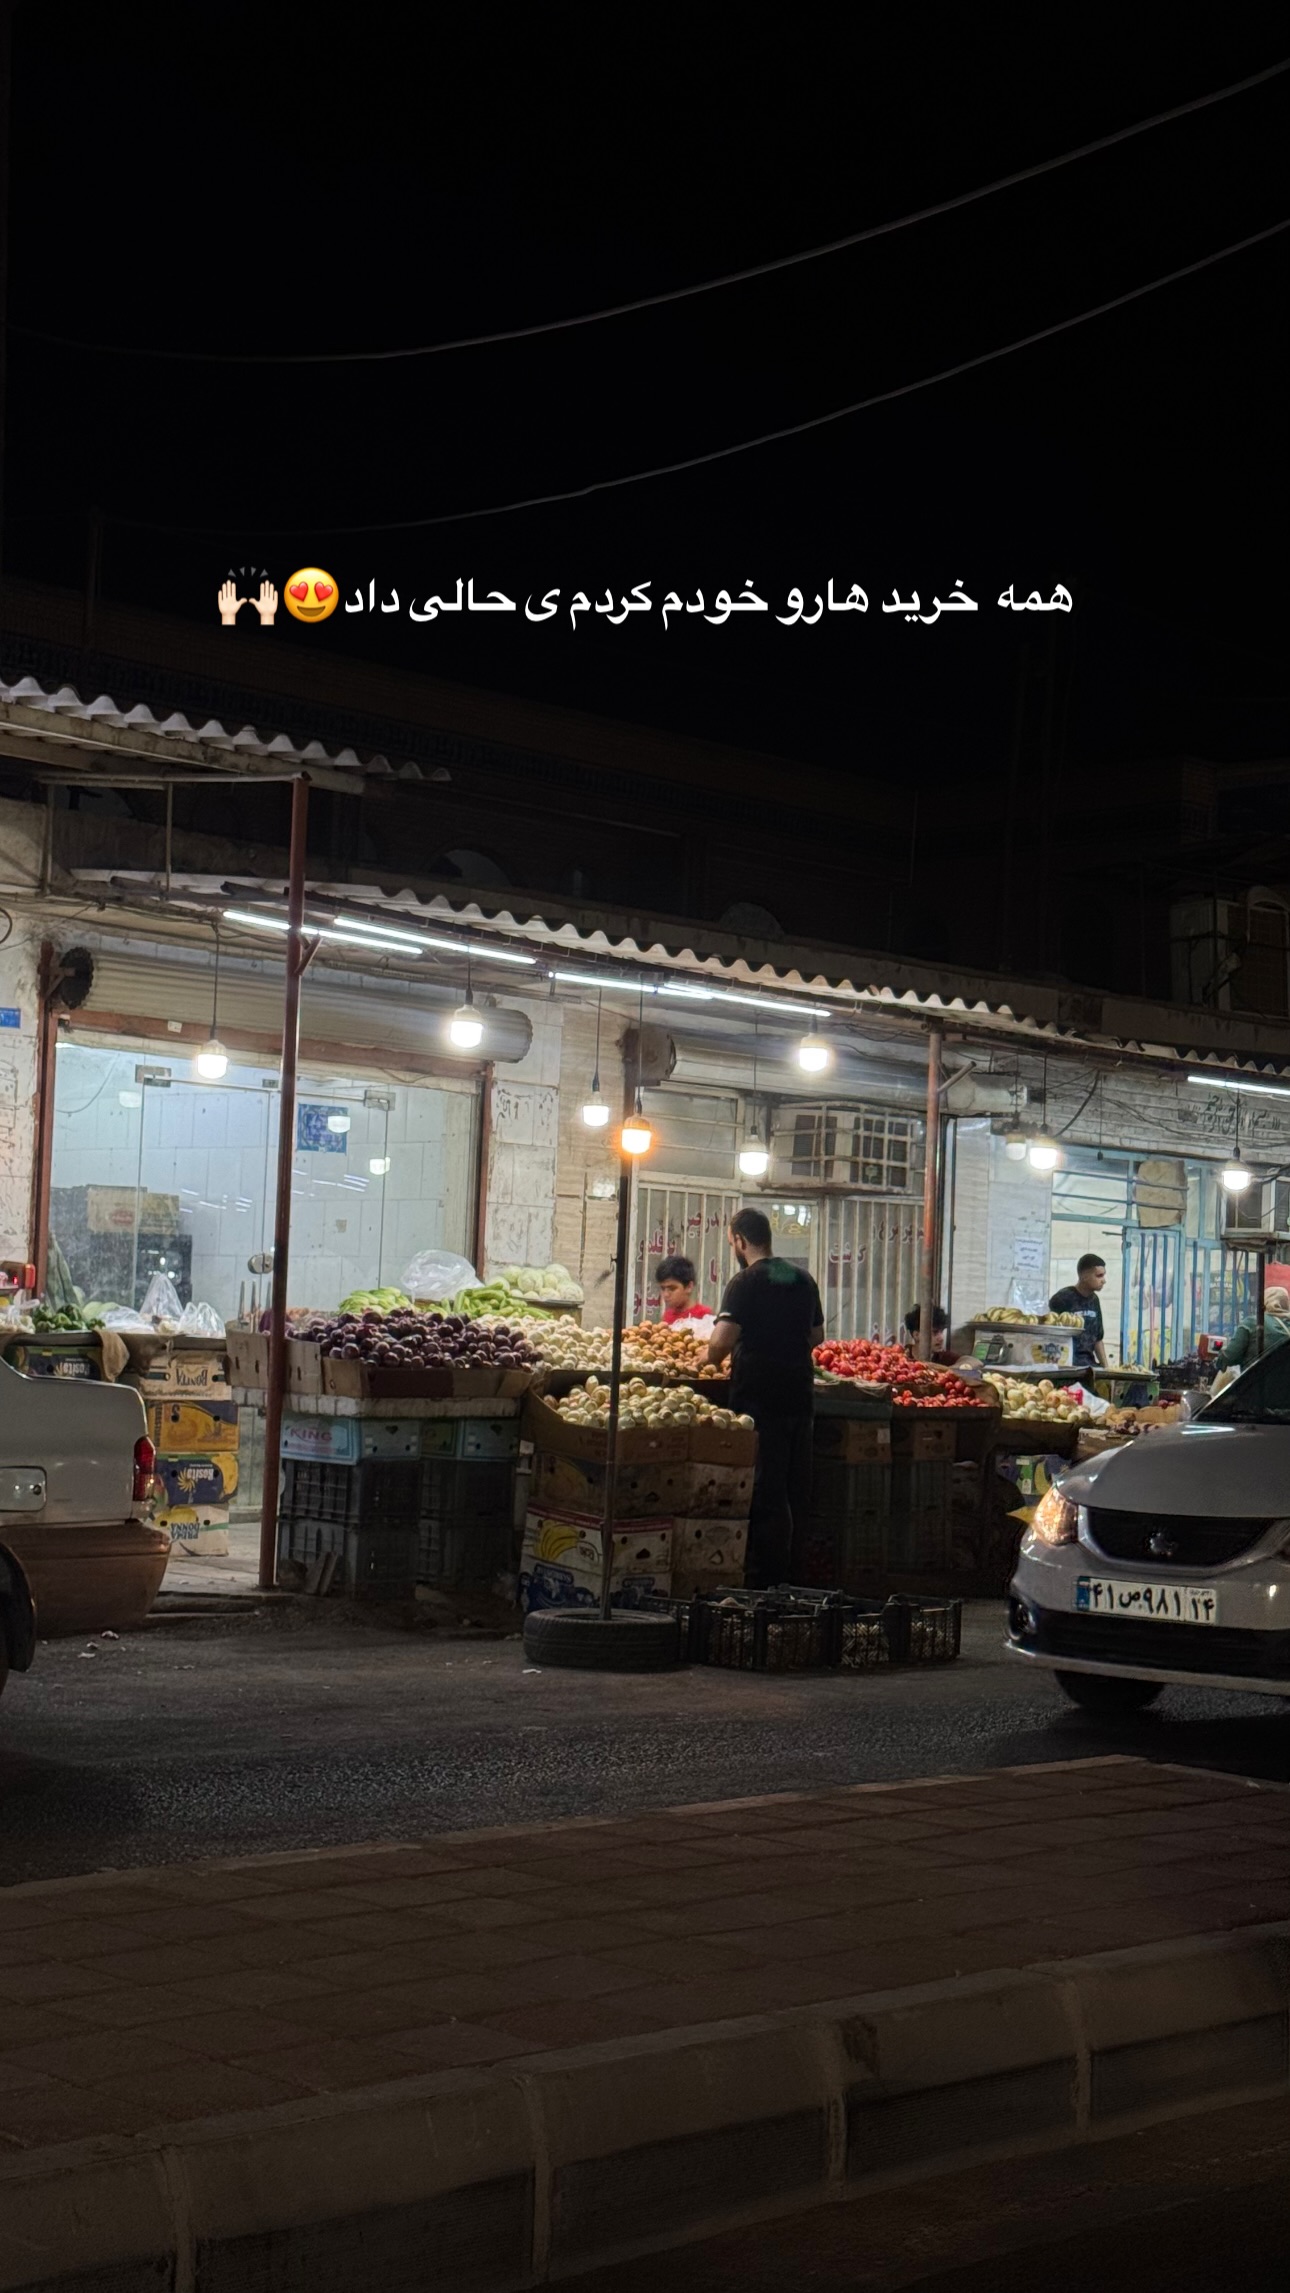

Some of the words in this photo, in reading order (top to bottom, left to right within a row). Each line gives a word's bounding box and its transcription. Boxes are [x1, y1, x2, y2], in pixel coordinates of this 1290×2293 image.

[829, 1243, 867, 1266] گشت
[175, 1367, 208, 1387] BONITA
[289, 1427, 333, 1443] KING
[170, 1523, 200, 1533] DONNA
